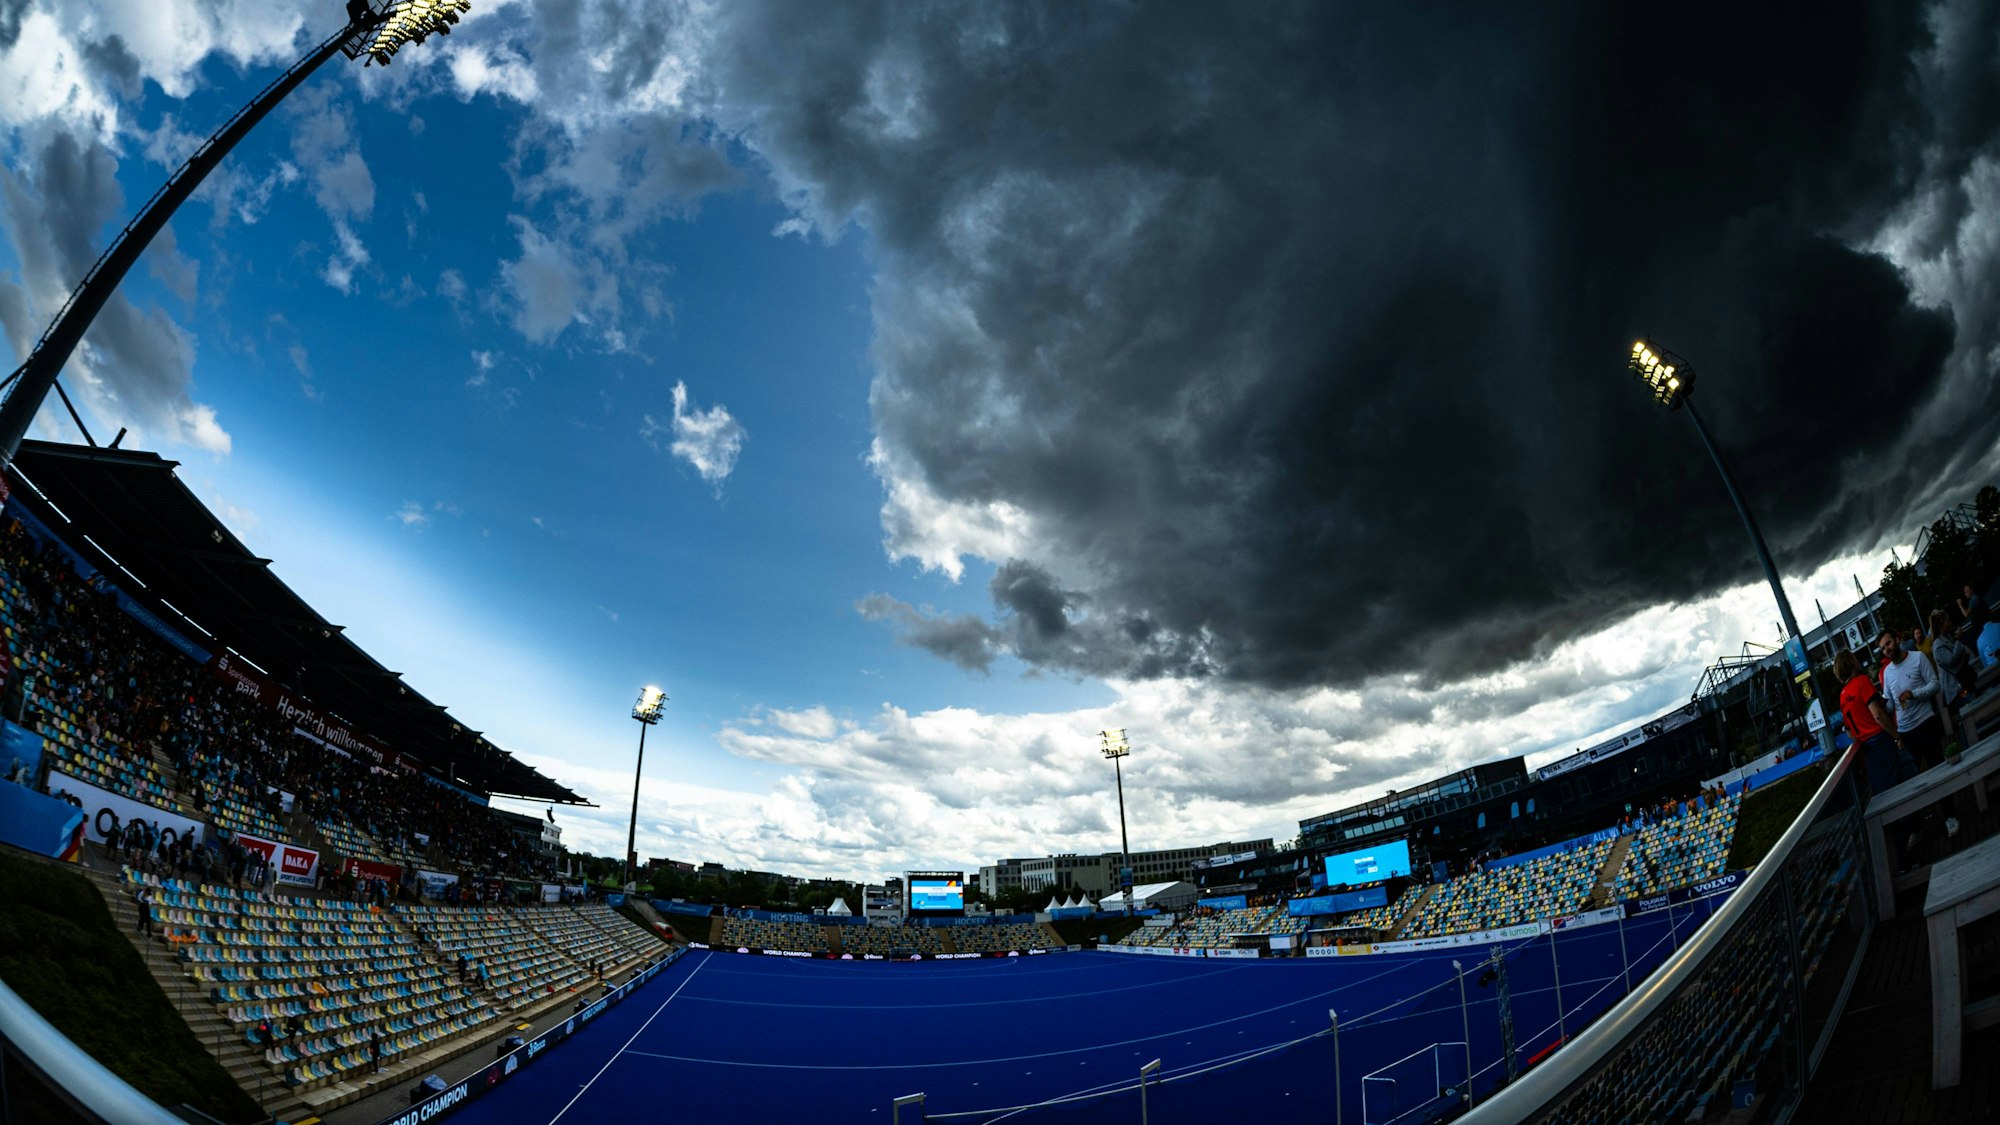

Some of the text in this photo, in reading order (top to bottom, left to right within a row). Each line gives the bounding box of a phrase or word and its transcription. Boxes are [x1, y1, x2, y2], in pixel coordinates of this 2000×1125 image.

[235, 680, 260, 699] park
[276, 695, 384, 765] Herzlich willkommen
[1593, 831, 1607, 842] ALL
[285, 854, 308, 869] DAKA
[1694, 875, 1736, 893] VOLVO
[1639, 895, 1667, 907] POLIGRAS
[770, 912, 809, 923] HOSTING
[955, 917, 986, 926] HOCKEY
[1509, 925, 1538, 937] lumosa
[421, 1083, 468, 1122] CHAMPION
